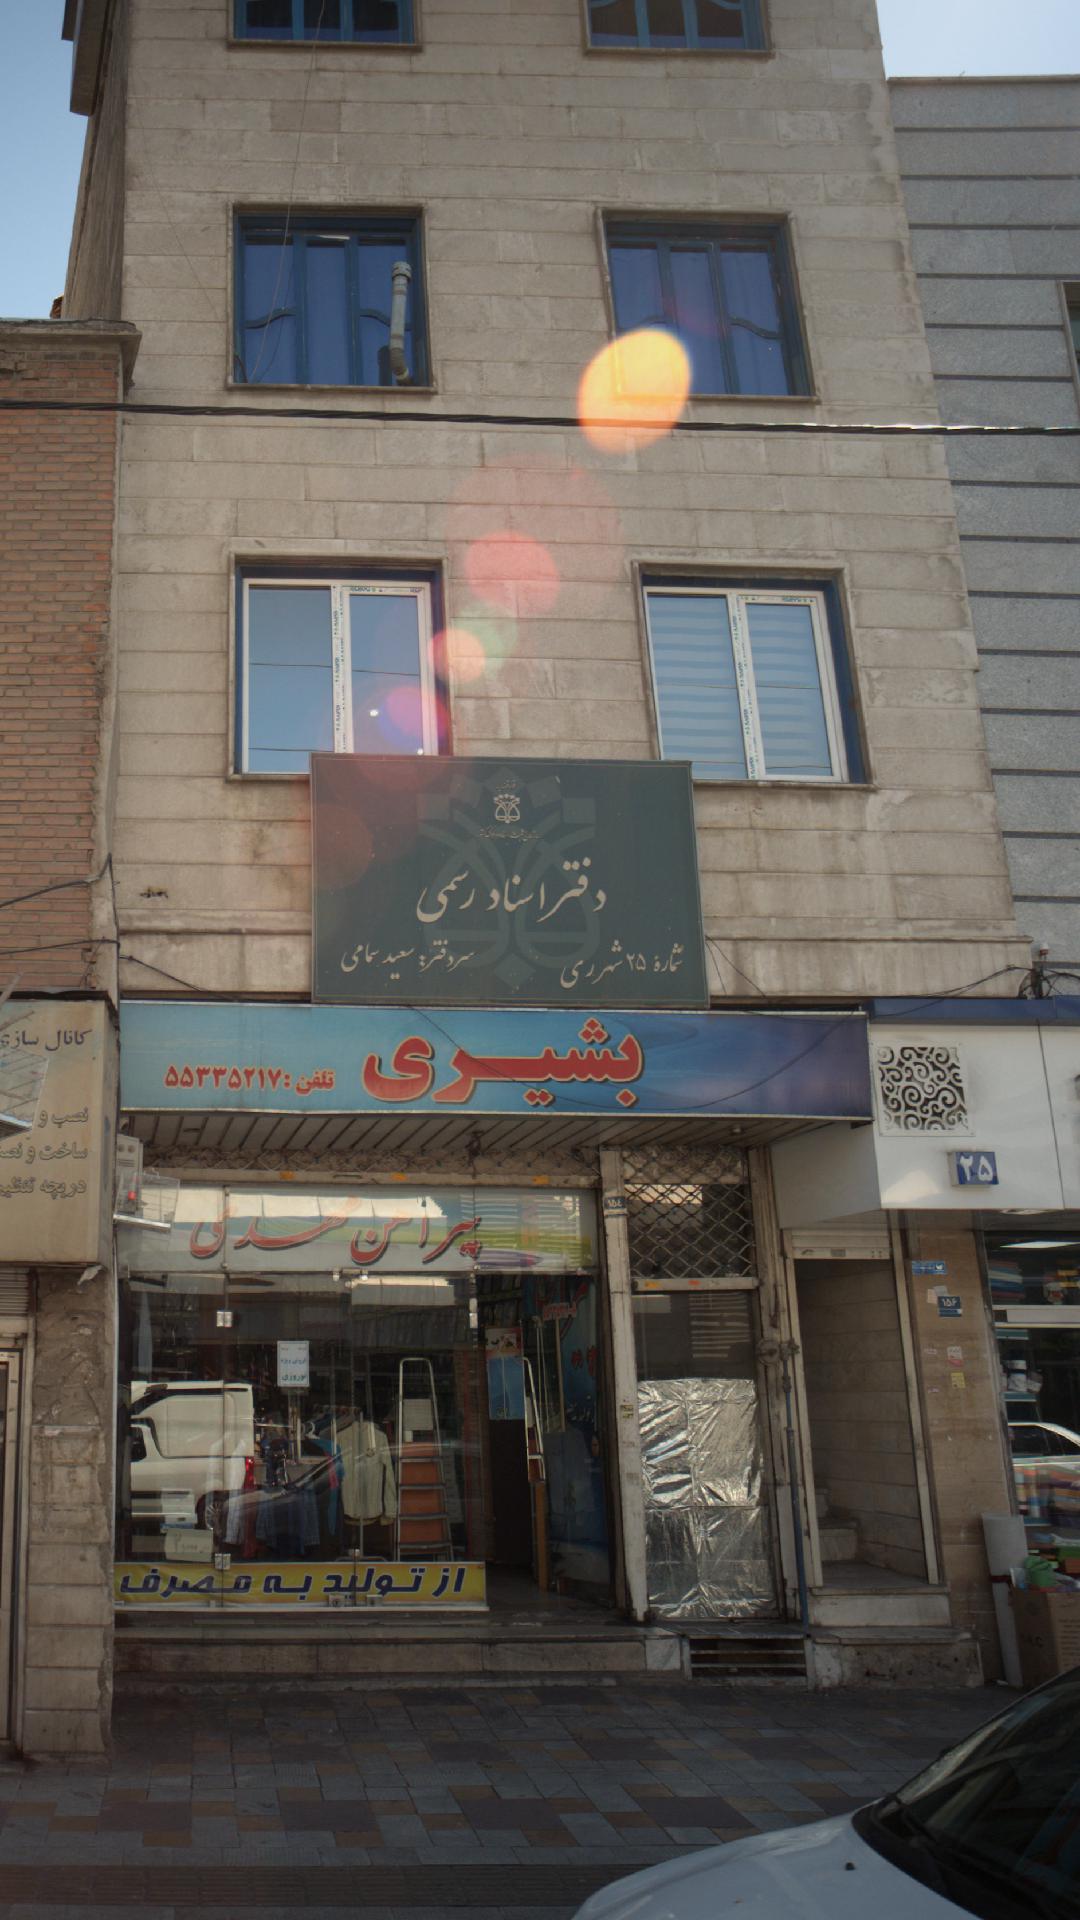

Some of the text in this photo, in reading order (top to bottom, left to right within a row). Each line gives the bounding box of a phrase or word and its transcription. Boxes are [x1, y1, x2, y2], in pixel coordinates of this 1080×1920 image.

[416, 856, 607, 923] دفتر اسناد رسمی
[381, 947, 416, 980] سعید
[560, 959, 595, 989] ری
[591, 939, 623, 984] شهر
[626, 952, 647, 972] ۲۵
[45, 1028, 92, 1051] کانال
[362, 1018, 645, 1107] بشیری
[164, 1064, 283, 1090] ۵۵۳۳۵۲۱۷
[52, 1105, 89, 1129] نصب
[0, 1142, 23, 1159] نص
[39, 1141, 88, 1161] ساخت
[959, 1155, 994, 1182] ۲۵
[40, 1178, 87, 1200] دریچه
[119, 1567, 466, 1600] از تولید به مصرف
